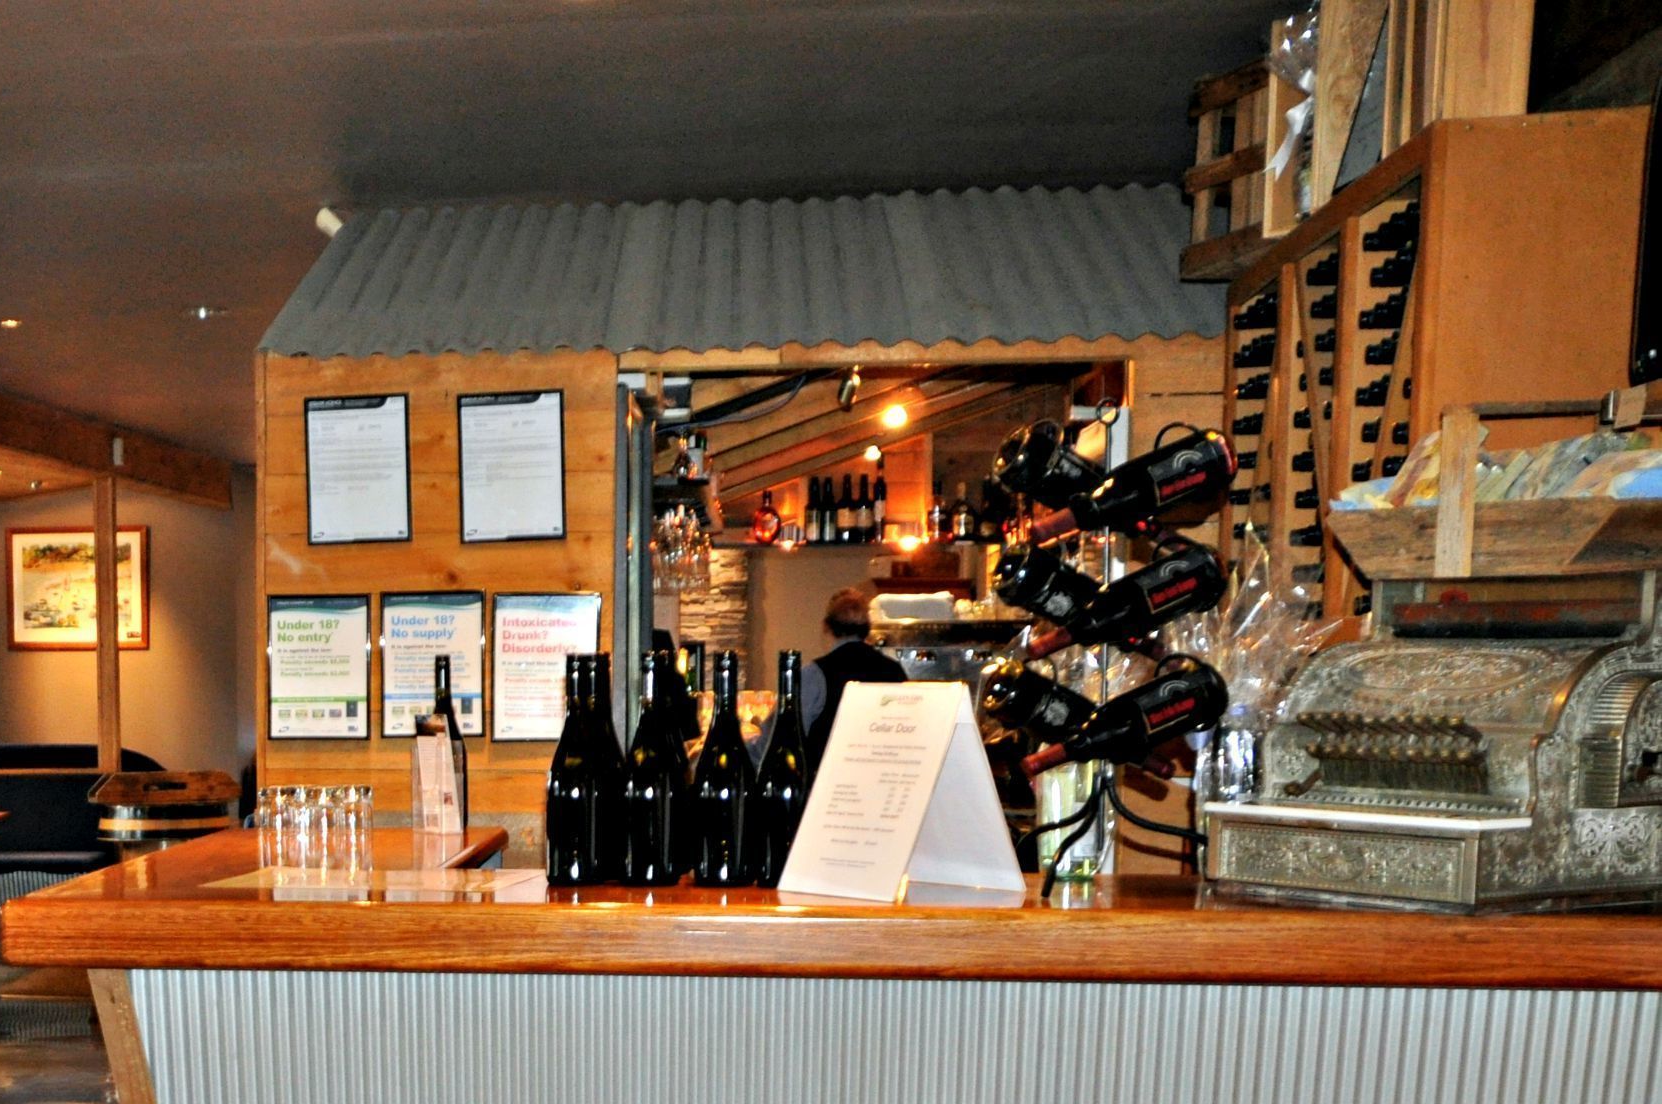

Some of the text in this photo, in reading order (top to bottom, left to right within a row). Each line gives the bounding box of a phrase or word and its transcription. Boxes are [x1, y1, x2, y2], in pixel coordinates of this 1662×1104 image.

[277, 619, 340, 630] Under 18?
[391, 615, 455, 626] Under 18?
[277, 633, 294, 642] No
[391, 629, 408, 638] No
[502, 630, 548, 641] Drunk?
[869, 722, 916, 734] Cellar Door
